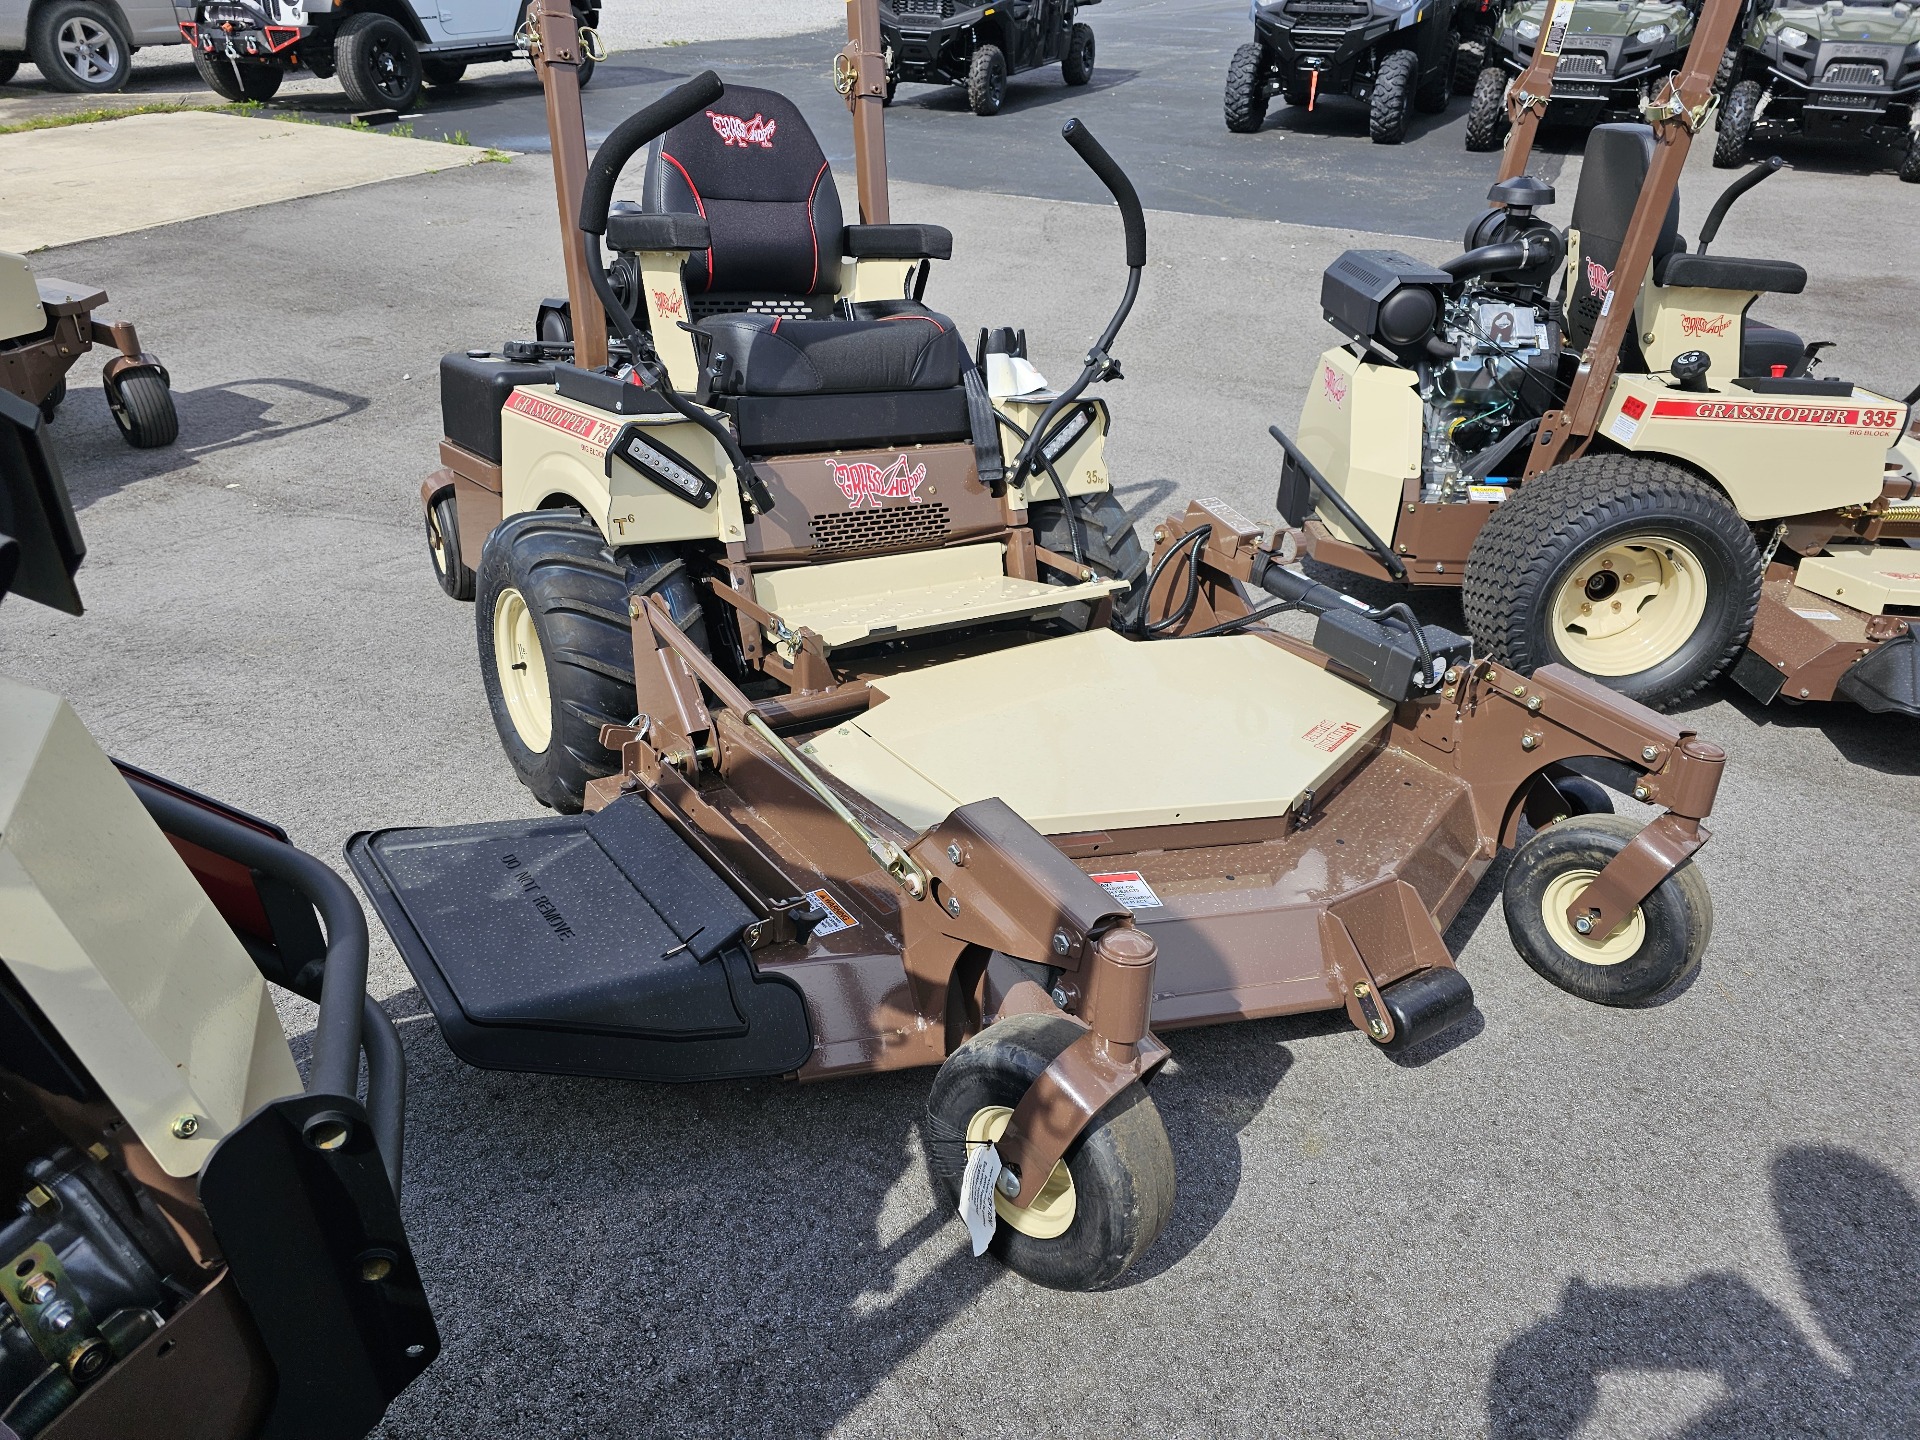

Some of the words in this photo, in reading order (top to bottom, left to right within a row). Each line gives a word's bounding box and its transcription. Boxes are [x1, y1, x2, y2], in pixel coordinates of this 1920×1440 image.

[513, 395, 592, 435] GRASSHOPPER
[592, 422, 618, 446] 735
[1695, 403, 1849, 424] GRASSHOPPER
[1862, 409, 1898, 428] 335
[501, 853, 522, 870] DO
[514, 871, 541, 893] NOT
[532, 895, 576, 942] REMOVE
[825, 898, 850, 922] WARNING
